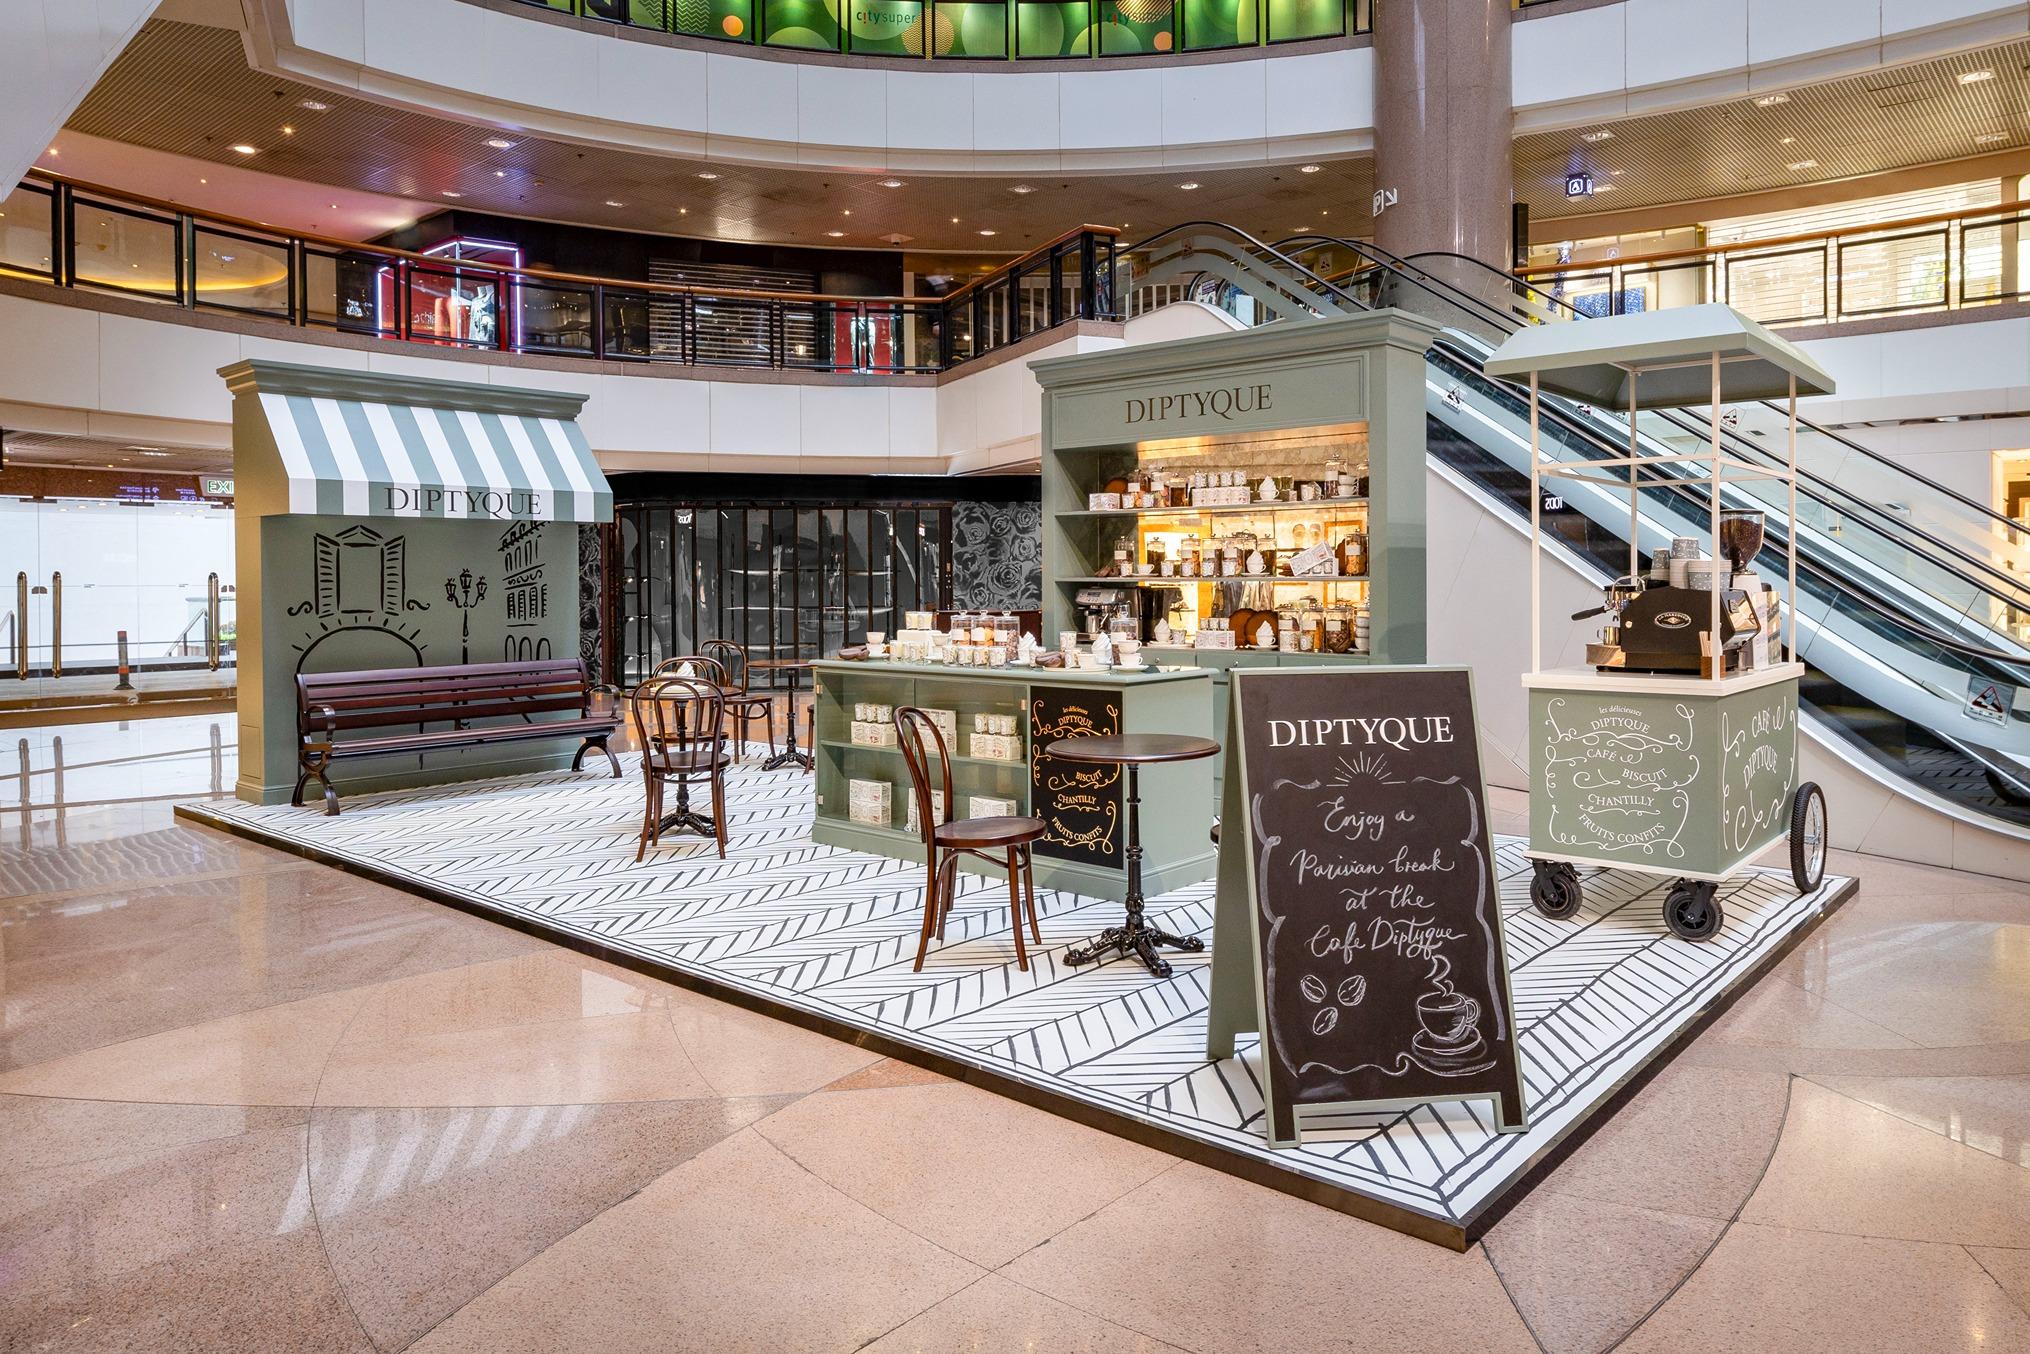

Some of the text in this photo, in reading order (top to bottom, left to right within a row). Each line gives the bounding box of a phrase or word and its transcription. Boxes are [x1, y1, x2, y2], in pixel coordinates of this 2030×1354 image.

[1125, 384, 1273, 424] DIPTYQUE
[207, 480, 234, 494] EXI
[384, 487, 542, 519] DIPTYQUE
[1058, 715, 1093, 729] DIPTYQUE
[1609, 705, 1642, 717] délicieuses
[1751, 707, 1770, 738] CAFÉ
[1268, 716, 1454, 751] DIPTYQUE
[1590, 717, 1651, 734] DIPTYQUE
[1586, 748, 1617, 762] CAFÉ
[1743, 744, 1778, 790] DIPTYQUE
[1075, 769, 1103, 783] BISCUIT
[1622, 768, 1668, 783] BISCUIT
[1058, 793, 1097, 805] CHANTILLY
[1588, 793, 1655, 807] CHANTILLY
[1052, 816, 1103, 842] FRUITS CONFITS
[1317, 796, 1415, 842] Enjoy a
[1578, 813, 1666, 844] FRUITS CONFITS
[1290, 845, 1455, 886] Parisian break
[1338, 884, 1436, 912] at the
[1304, 915, 1468, 965] Cafe Diptyque
